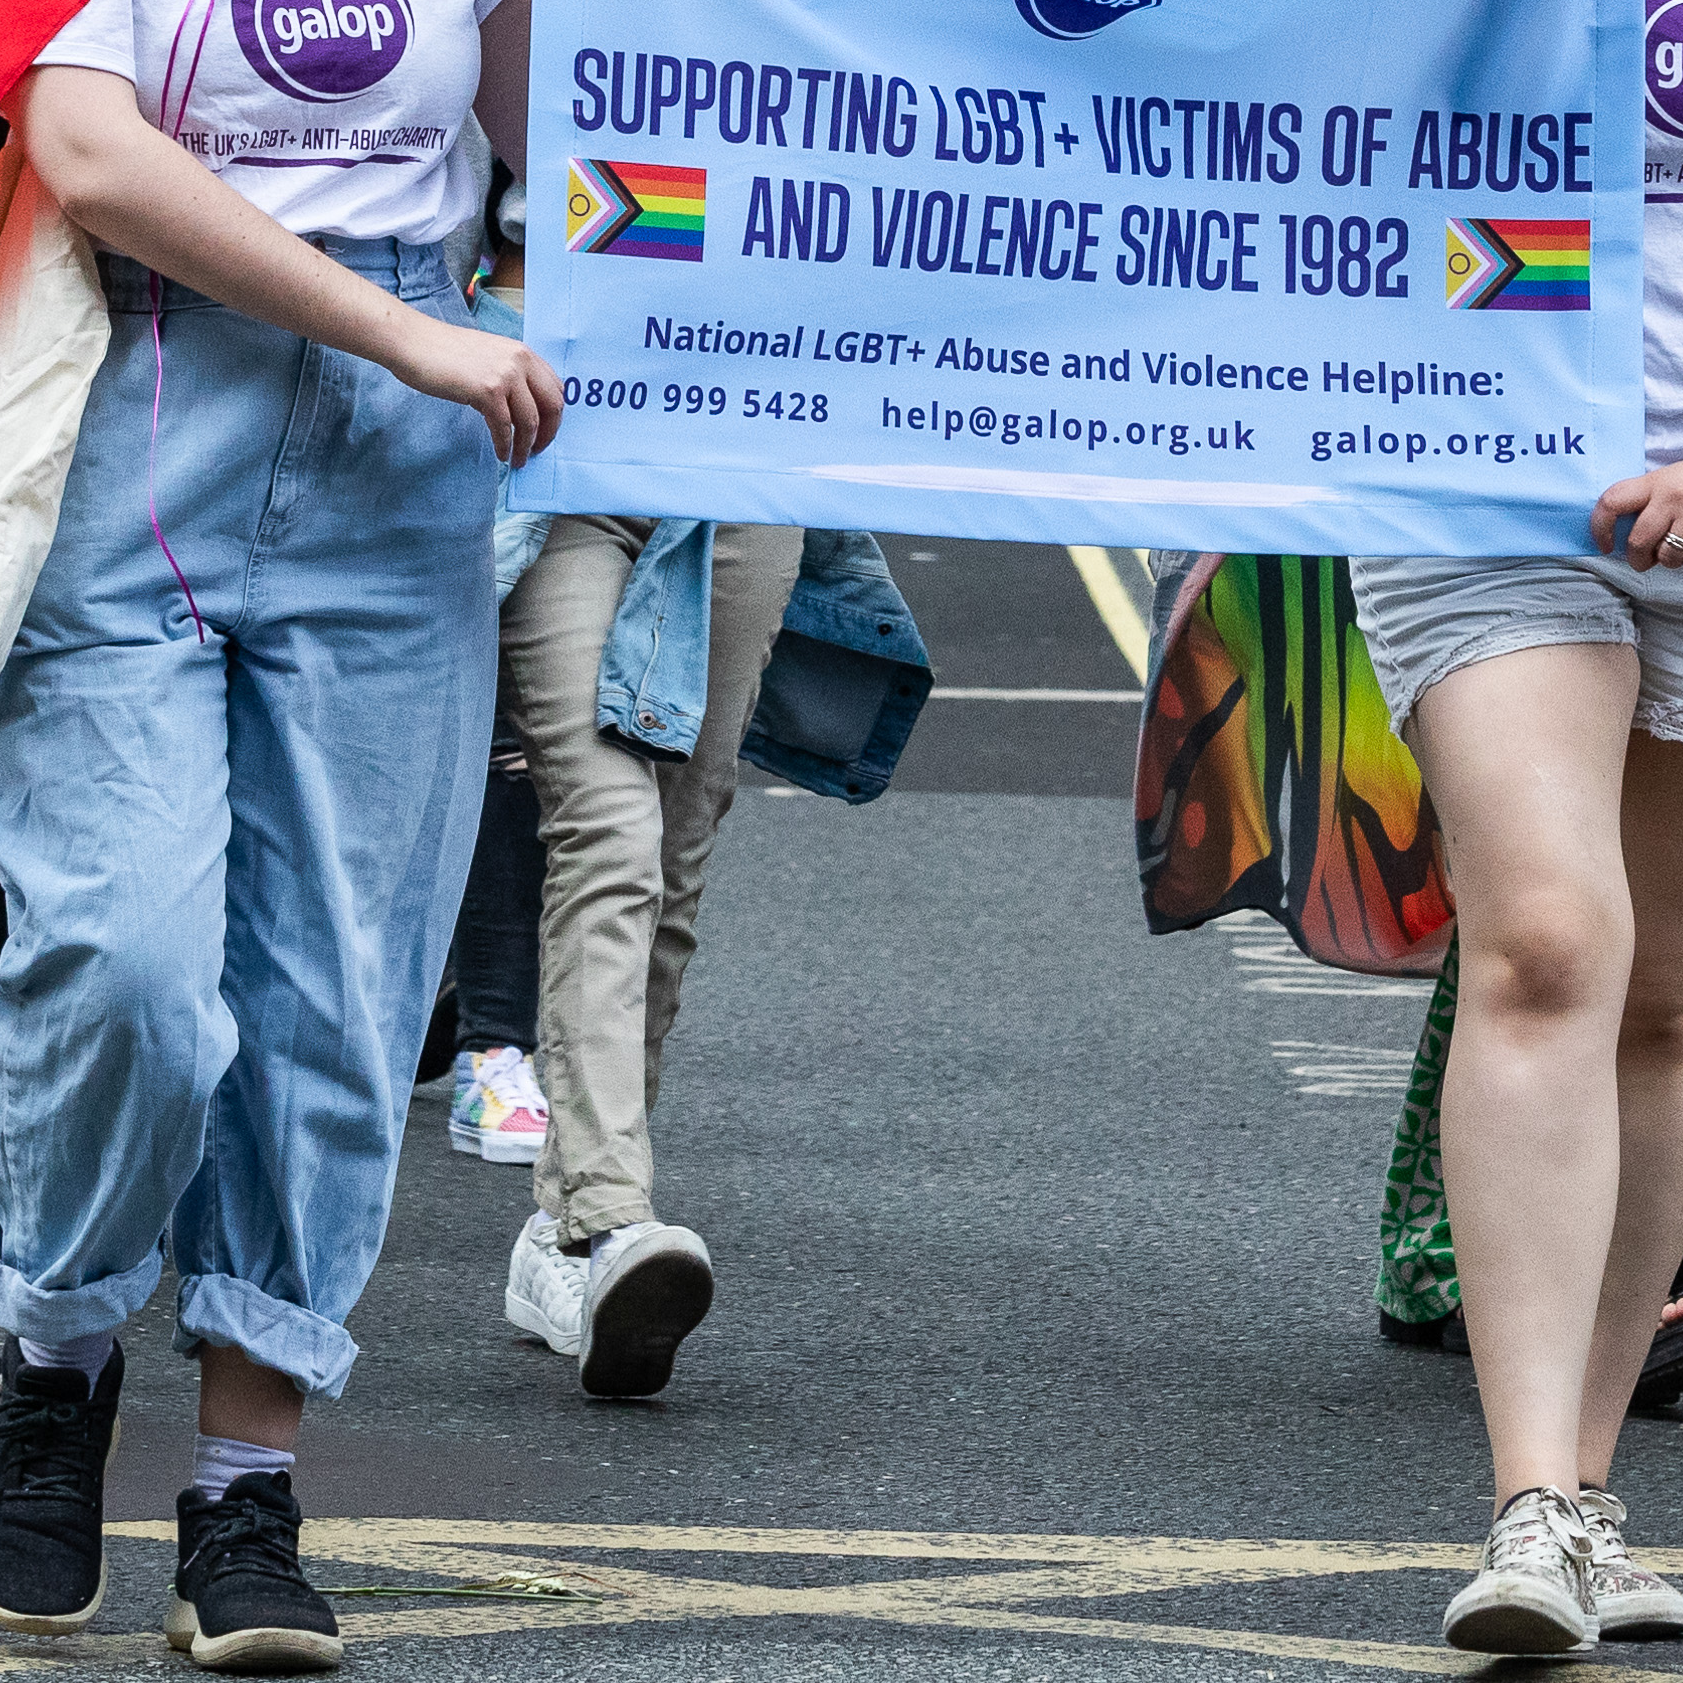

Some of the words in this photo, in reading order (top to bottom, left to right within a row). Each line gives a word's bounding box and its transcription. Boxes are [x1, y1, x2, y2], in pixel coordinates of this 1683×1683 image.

[178, 131, 210, 154] THE
[250, 129, 297, 150] LGBT+
[392, 127, 447, 150] CHARITY
[573, 48, 918, 159] SUPPORTING
[931, 84, 1080, 169] LGBT+
[1092, 94, 1303, 184] VICTIMS
[1321, 105, 1394, 187] OF
[1408, 110, 1594, 194] ABUSE
[1645, 162, 1673, 184] BT+
[741, 176, 851, 264] AND
[872, 185, 1103, 283] VIOLENCE
[1116, 205, 1259, 292] SINCE
[1279, 214, 1410, 299] 1982
[644, 317, 804, 360] National
[813, 329, 927, 368] LGBT+
[935, 336, 1050, 378] Abuse
[1061, 349, 1132, 383] and
[1142, 351, 1309, 392] Violence
[1322, 360, 1505, 404] Helpline:
[563, 374, 648, 412] 0800
[663, 382, 728, 416] 999
[743, 389, 830, 424] 5428
[882, 397, 1256, 452] help@galop.org.uk
[1311, 422, 1586, 463] galop.org.uk
